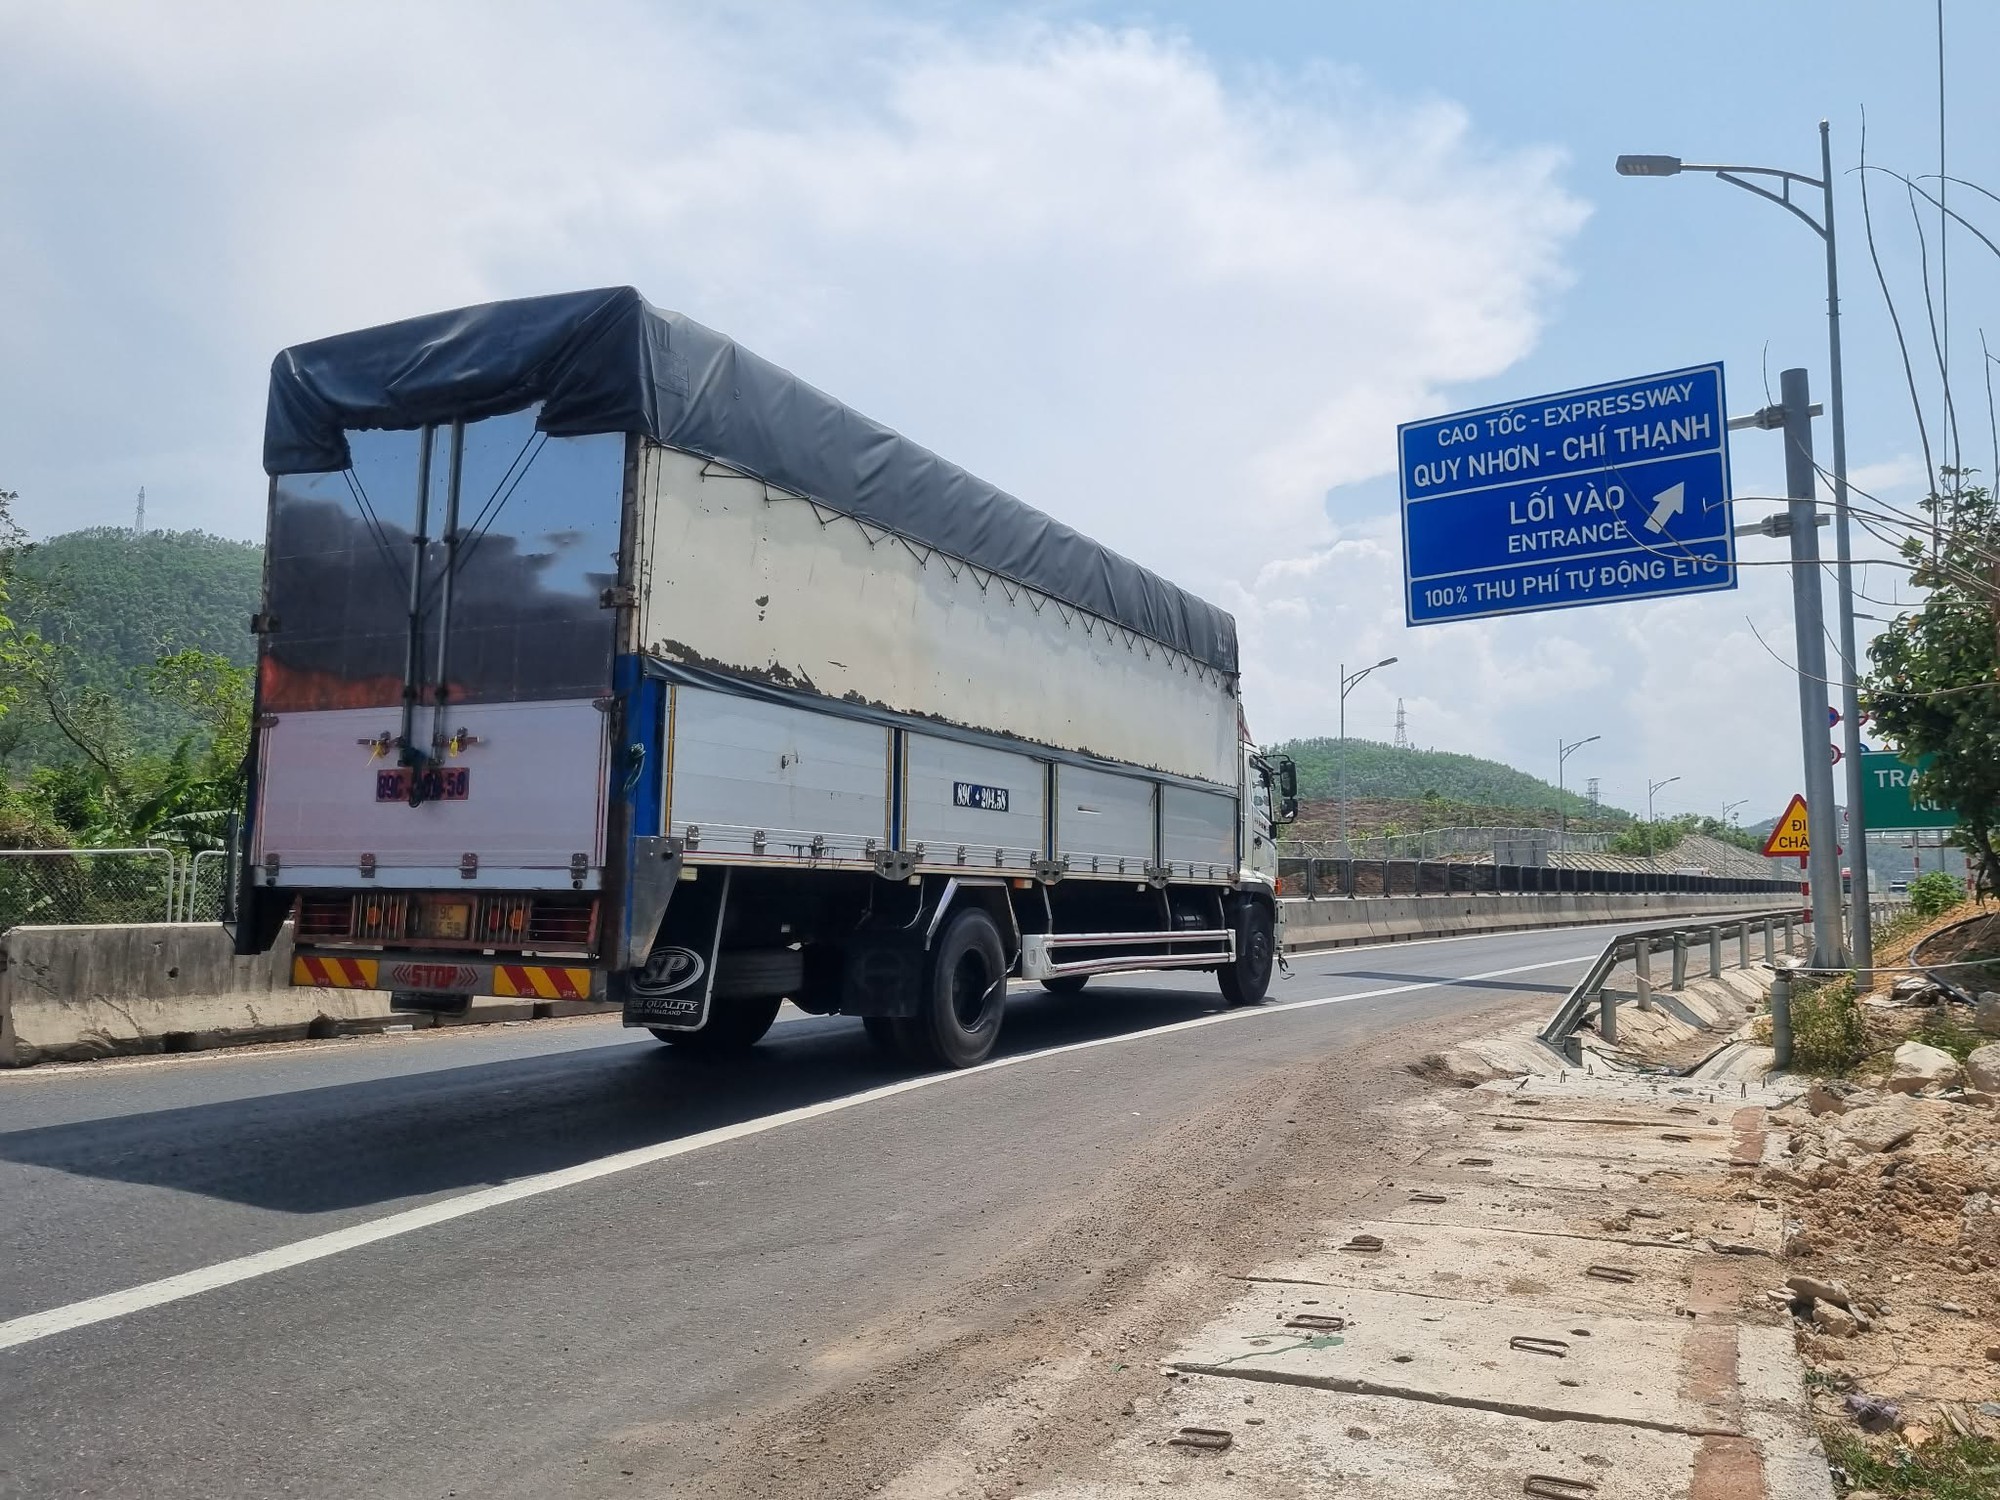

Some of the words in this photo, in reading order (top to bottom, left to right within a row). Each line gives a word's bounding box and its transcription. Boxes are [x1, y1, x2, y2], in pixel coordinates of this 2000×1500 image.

[1437, 422, 1478, 447] CAO
[1485, 409, 1527, 437] TỐC
[1544, 382, 1694, 427] EXPRESSWAY
[1414, 457, 1462, 488] QUY
[1468, 443, 1540, 478] NHƠN
[1562, 424, 1607, 462] CHÍ
[1613, 413, 1711, 452] THẠNH
[1509, 485, 1555, 525] LỐI
[1563, 482, 1625, 516] VÀO
[1508, 520, 1628, 553] ENTRANCE
[1425, 585, 1468, 608] 100%
[1472, 579, 1516, 601] THU
[1522, 567, 1561, 595] PHÍ
[1565, 566, 1596, 592] TỰ
[1600, 559, 1666, 588] ĐỘNG
[1673, 553, 1719, 577] ETC
[1778, 834, 1810, 850] CHẬ
[1791, 819, 1807, 832] ĐI
[410, 964, 459, 989] STOP
[646, 999, 699, 1011] QUALITY
